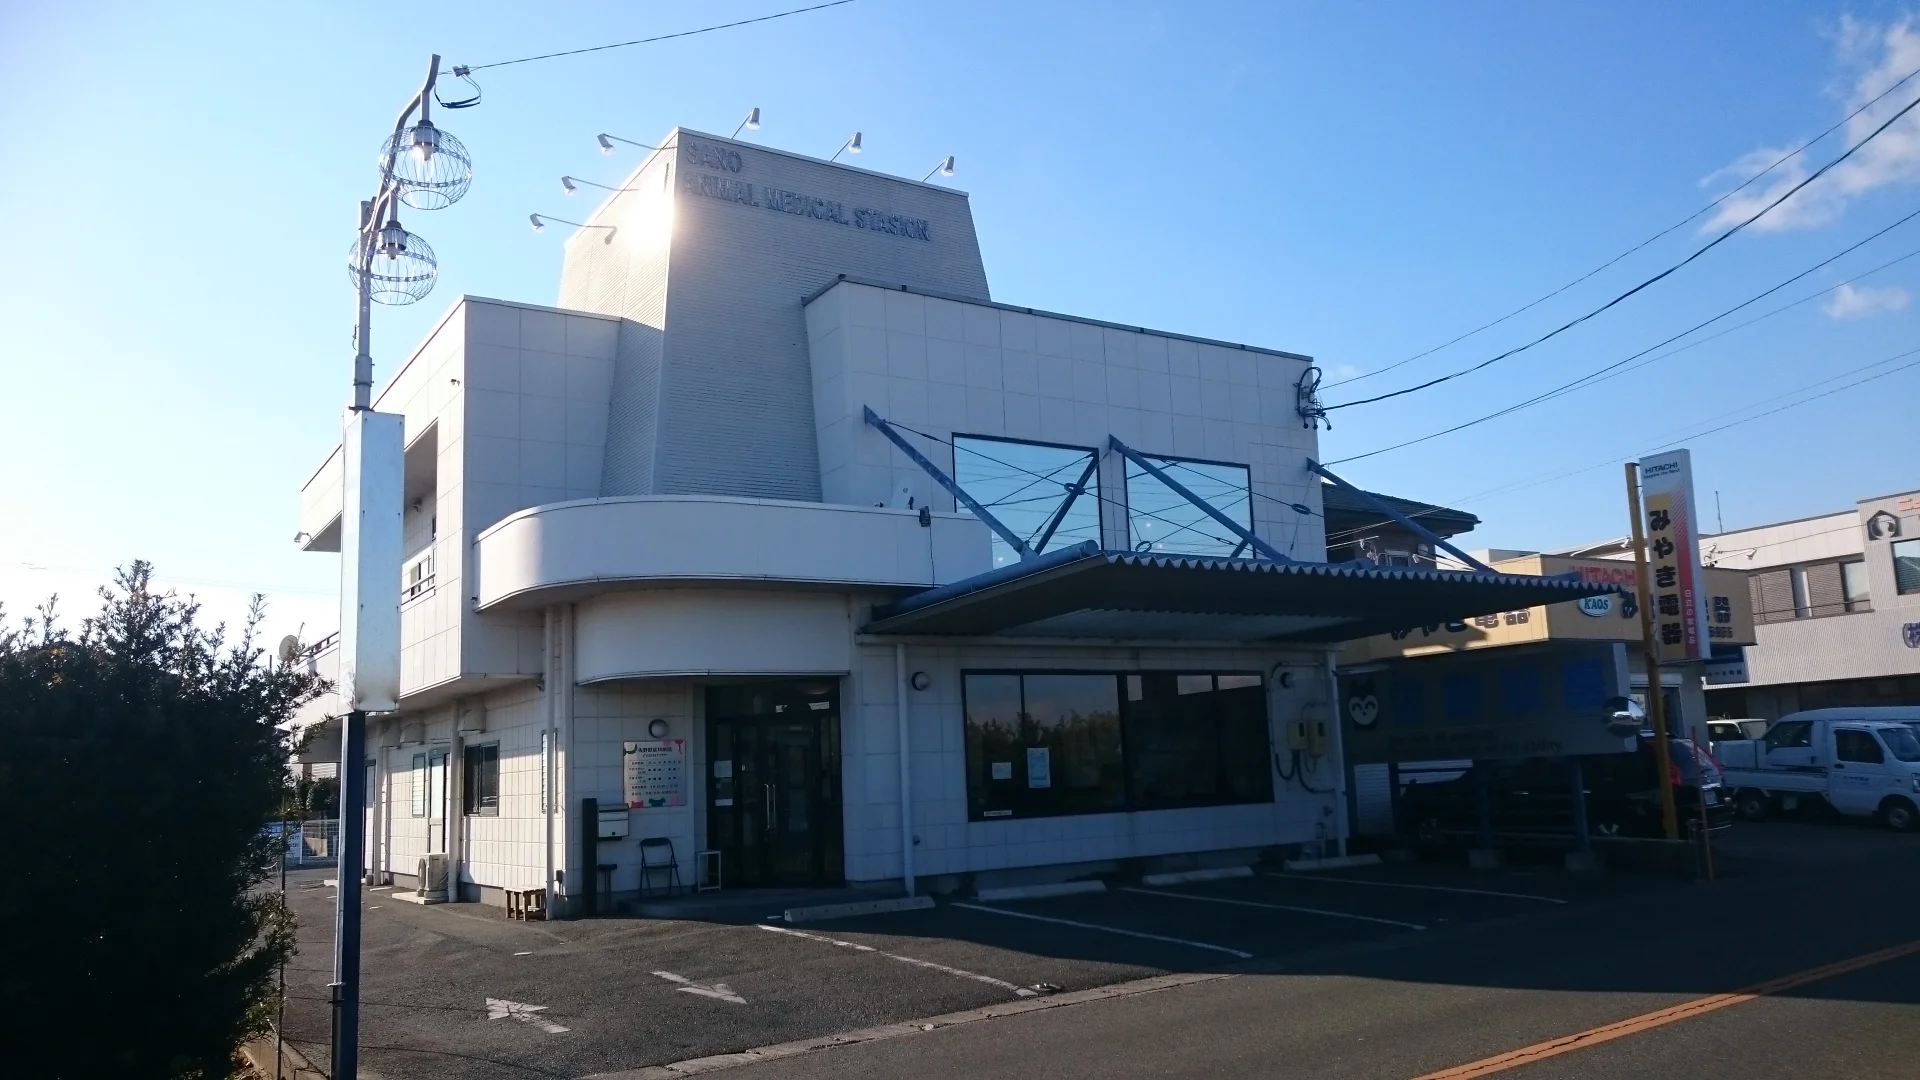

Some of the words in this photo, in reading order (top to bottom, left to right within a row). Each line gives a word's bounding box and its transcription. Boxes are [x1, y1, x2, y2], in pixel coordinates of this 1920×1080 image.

[687, 141, 742, 173] SANO
[684, 171, 759, 207] ANIMAL
[764, 188, 848, 225] MEDICAL
[1645, 461, 1678, 474] HITACHI
[1649, 509, 1682, 646] みやき電器
